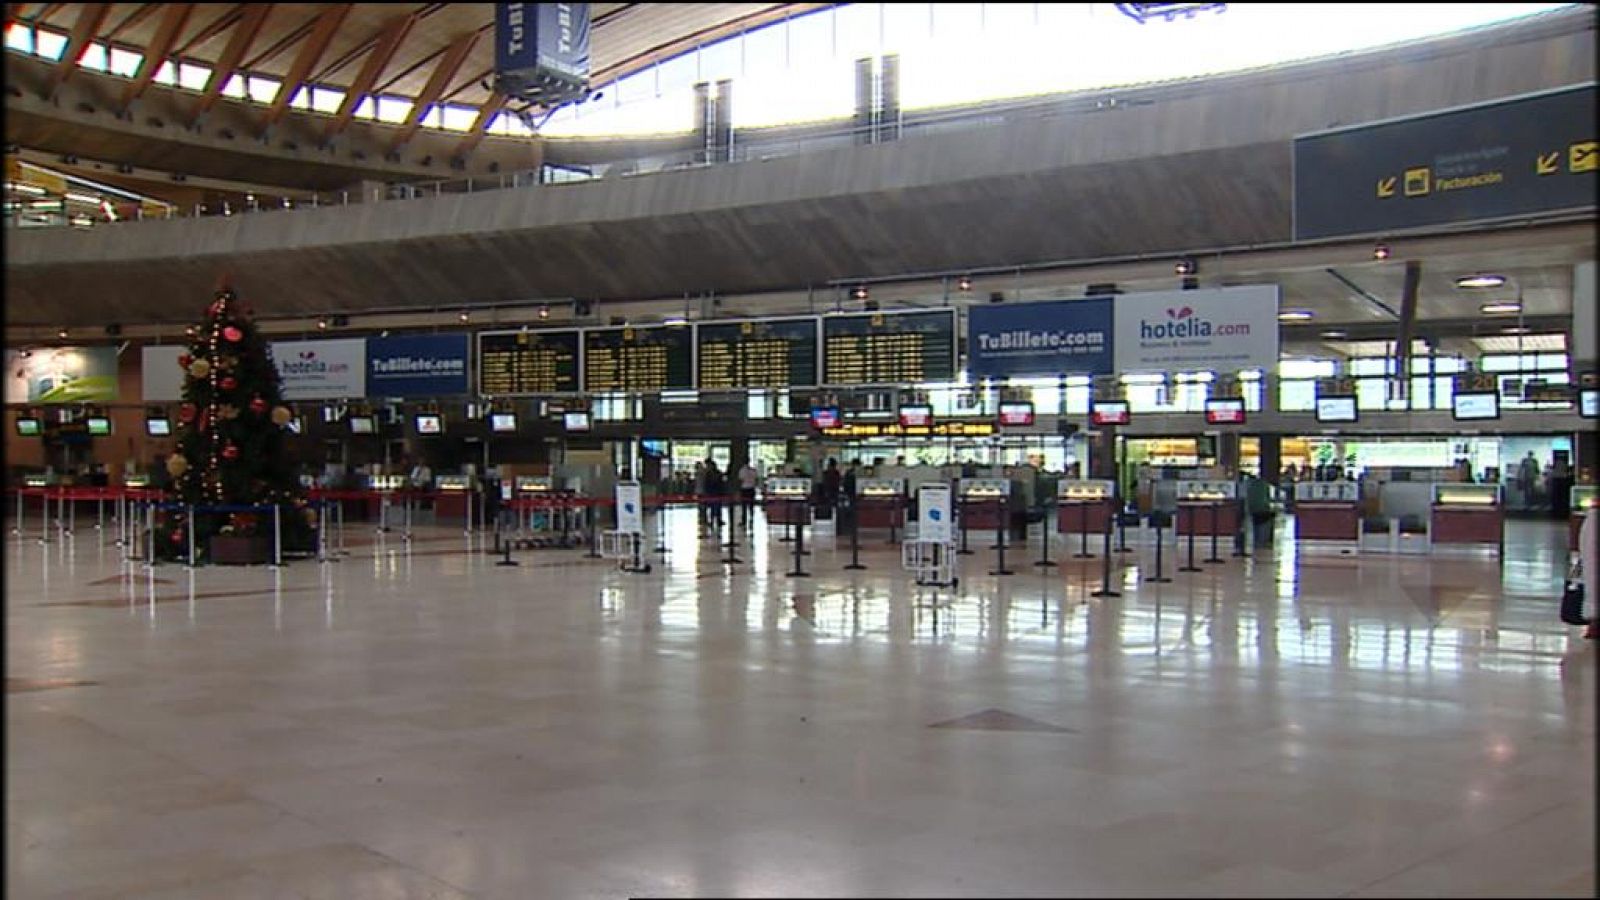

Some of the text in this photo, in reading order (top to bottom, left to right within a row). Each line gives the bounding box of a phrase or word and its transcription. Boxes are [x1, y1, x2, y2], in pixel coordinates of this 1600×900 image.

[1437, 173, 1503, 190] Facturación
[1141, 317, 1250, 339] hotelia.com
[284, 358, 348, 372] hotelia.com
